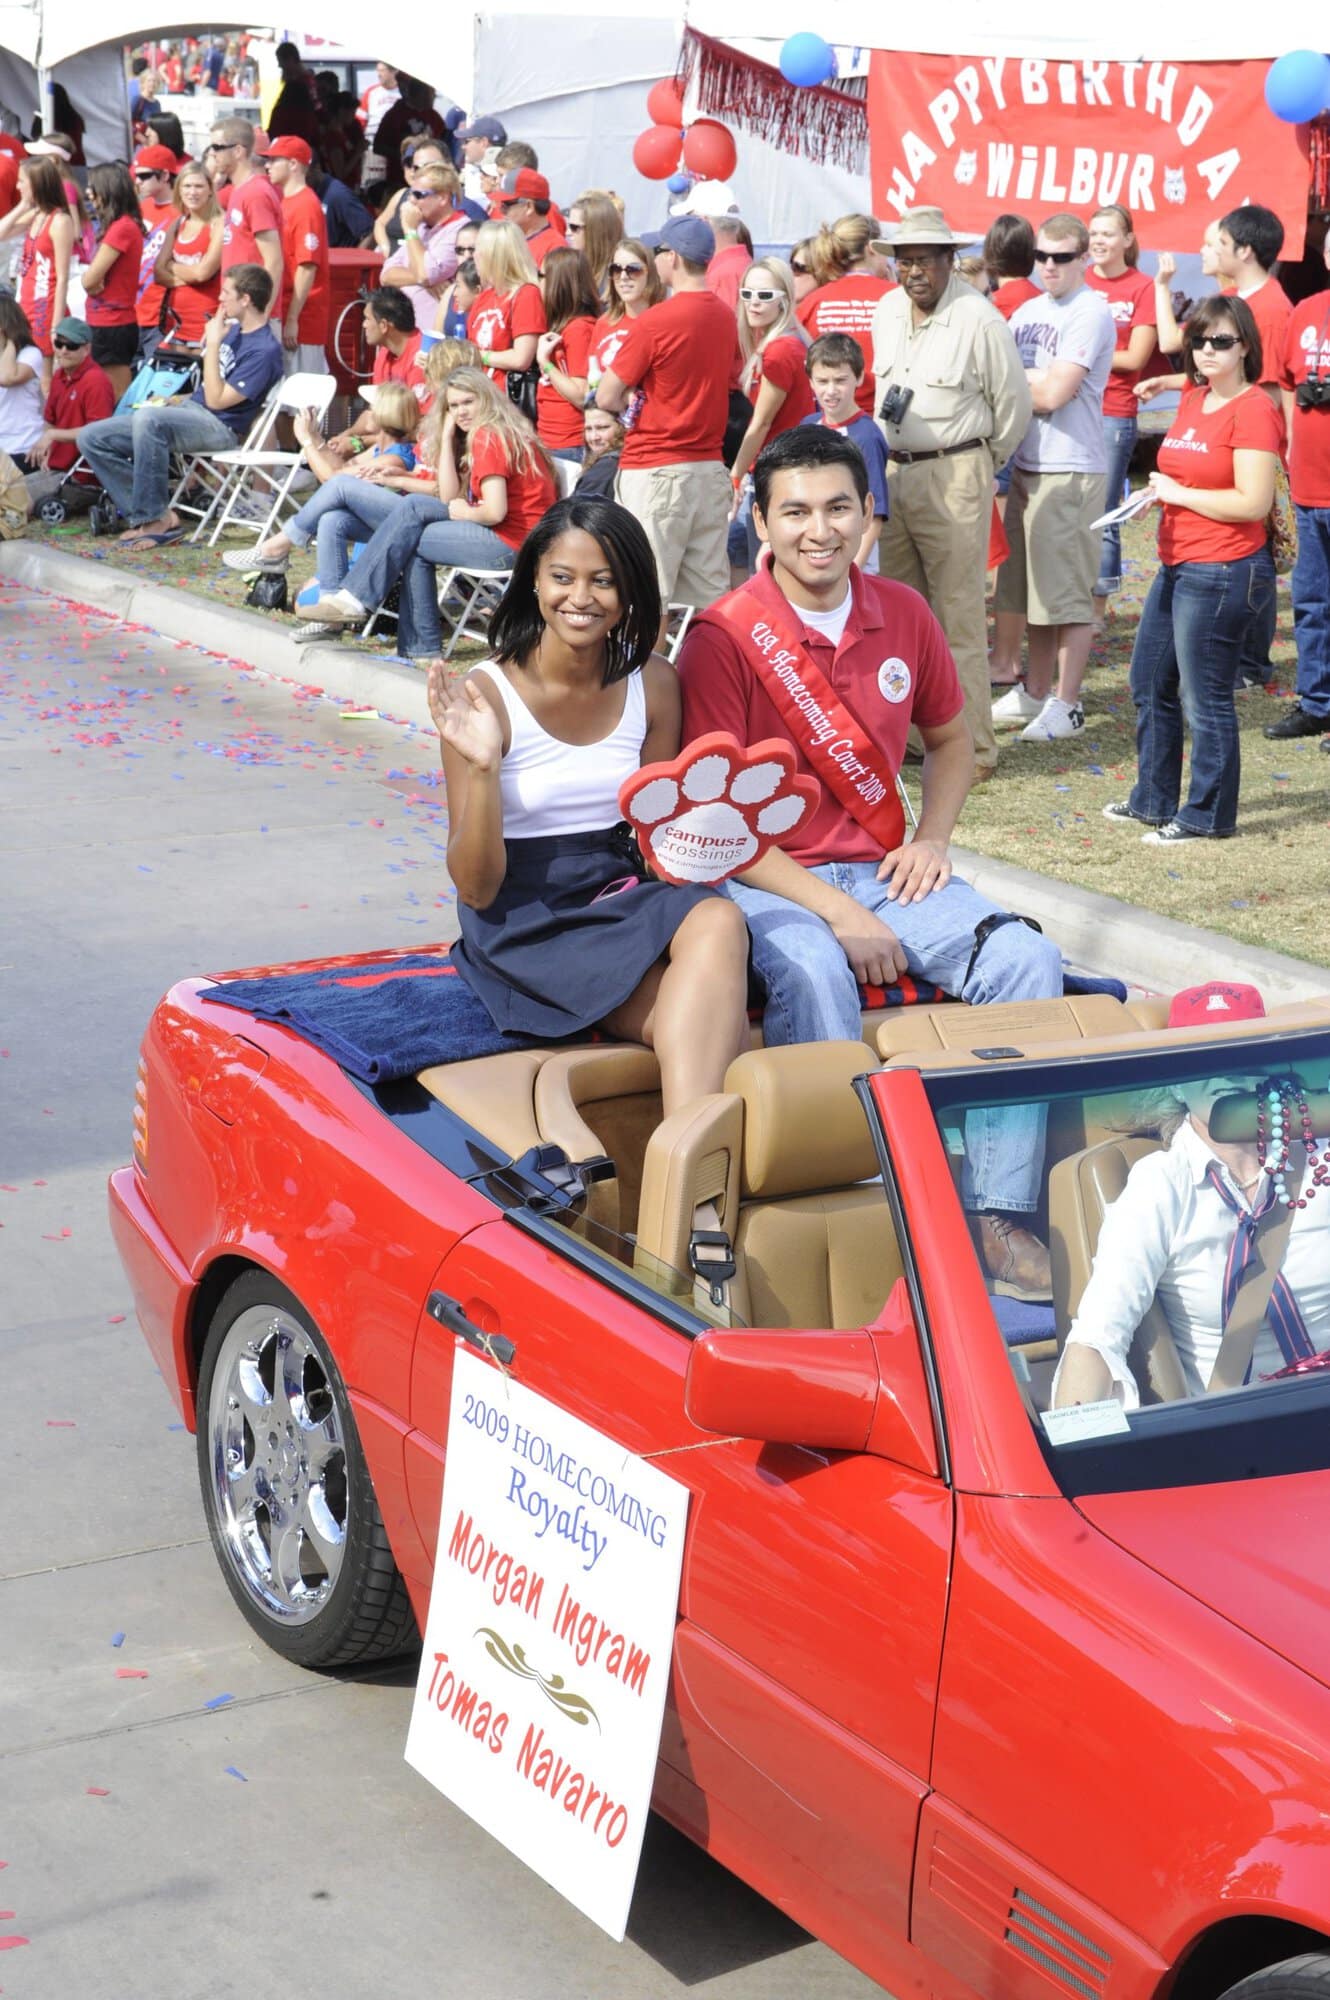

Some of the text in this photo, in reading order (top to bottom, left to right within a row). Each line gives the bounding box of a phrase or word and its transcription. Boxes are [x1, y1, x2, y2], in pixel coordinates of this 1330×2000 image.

[886, 57, 1250, 215] HAPPY BIRTHDA
[767, 648, 837, 746] Homecoming
[827, 739, 866, 781] Court
[854, 773, 887, 806] 2009
[660, 838, 743, 863] crossings
[665, 826, 734, 849] campus
[462, 1394, 667, 1548] 2009 HOMECOMING
[506, 1466, 608, 1571] Royalty
[448, 1509, 651, 1697] Morgan Ingram
[428, 1652, 628, 1848] Tomas Navarro
